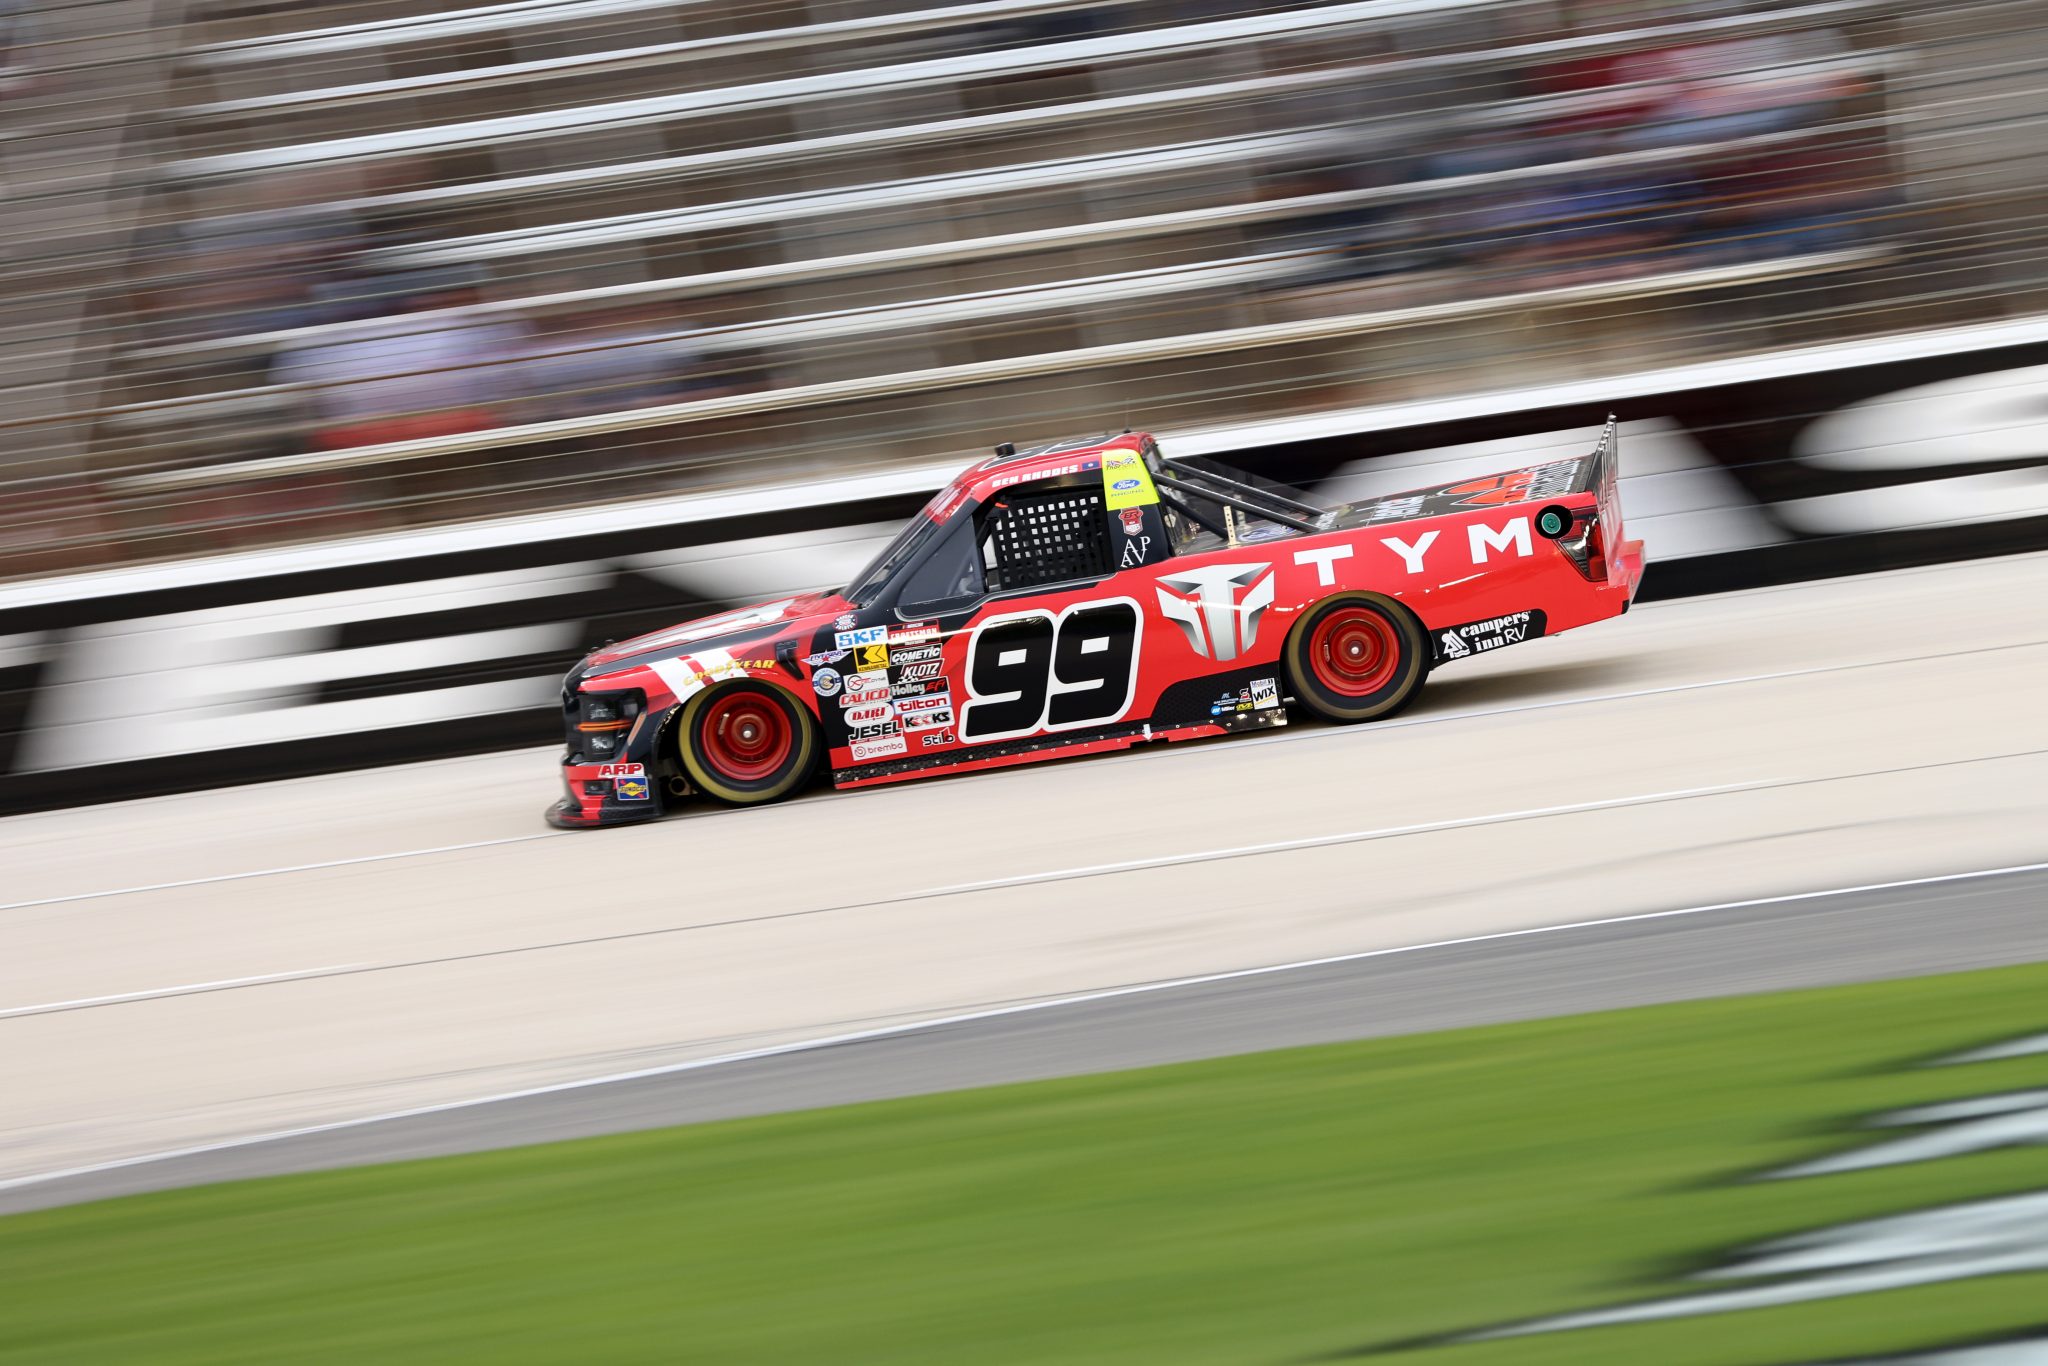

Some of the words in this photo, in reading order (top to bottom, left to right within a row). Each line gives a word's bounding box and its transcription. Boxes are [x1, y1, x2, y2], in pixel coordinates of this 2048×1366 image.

[992, 475, 1019, 488] BEN
[1022, 464, 1079, 482] RHODES
[1117, 480, 1136, 490] Ford
[1294, 516, 1533, 586] TYM
[1459, 611, 1530, 638] campers
[839, 628, 885, 647] SKF
[890, 627, 937, 641] CRAFTSMAN
[1474, 635, 1506, 652] inn
[1503, 624, 1528, 643] RV
[892, 646, 940, 663] COMETIC
[903, 662, 940, 678] KLOTZ
[963, 602, 1138, 739] 99
[841, 688, 889, 706] CALICO
[891, 683, 926, 696] Holley
[1253, 686, 1275, 702] WIX
[897, 696, 948, 713] tilton
[849, 721, 900, 740] JESEL
[867, 742, 904, 754] brembo
[601, 764, 641, 776] ARP
